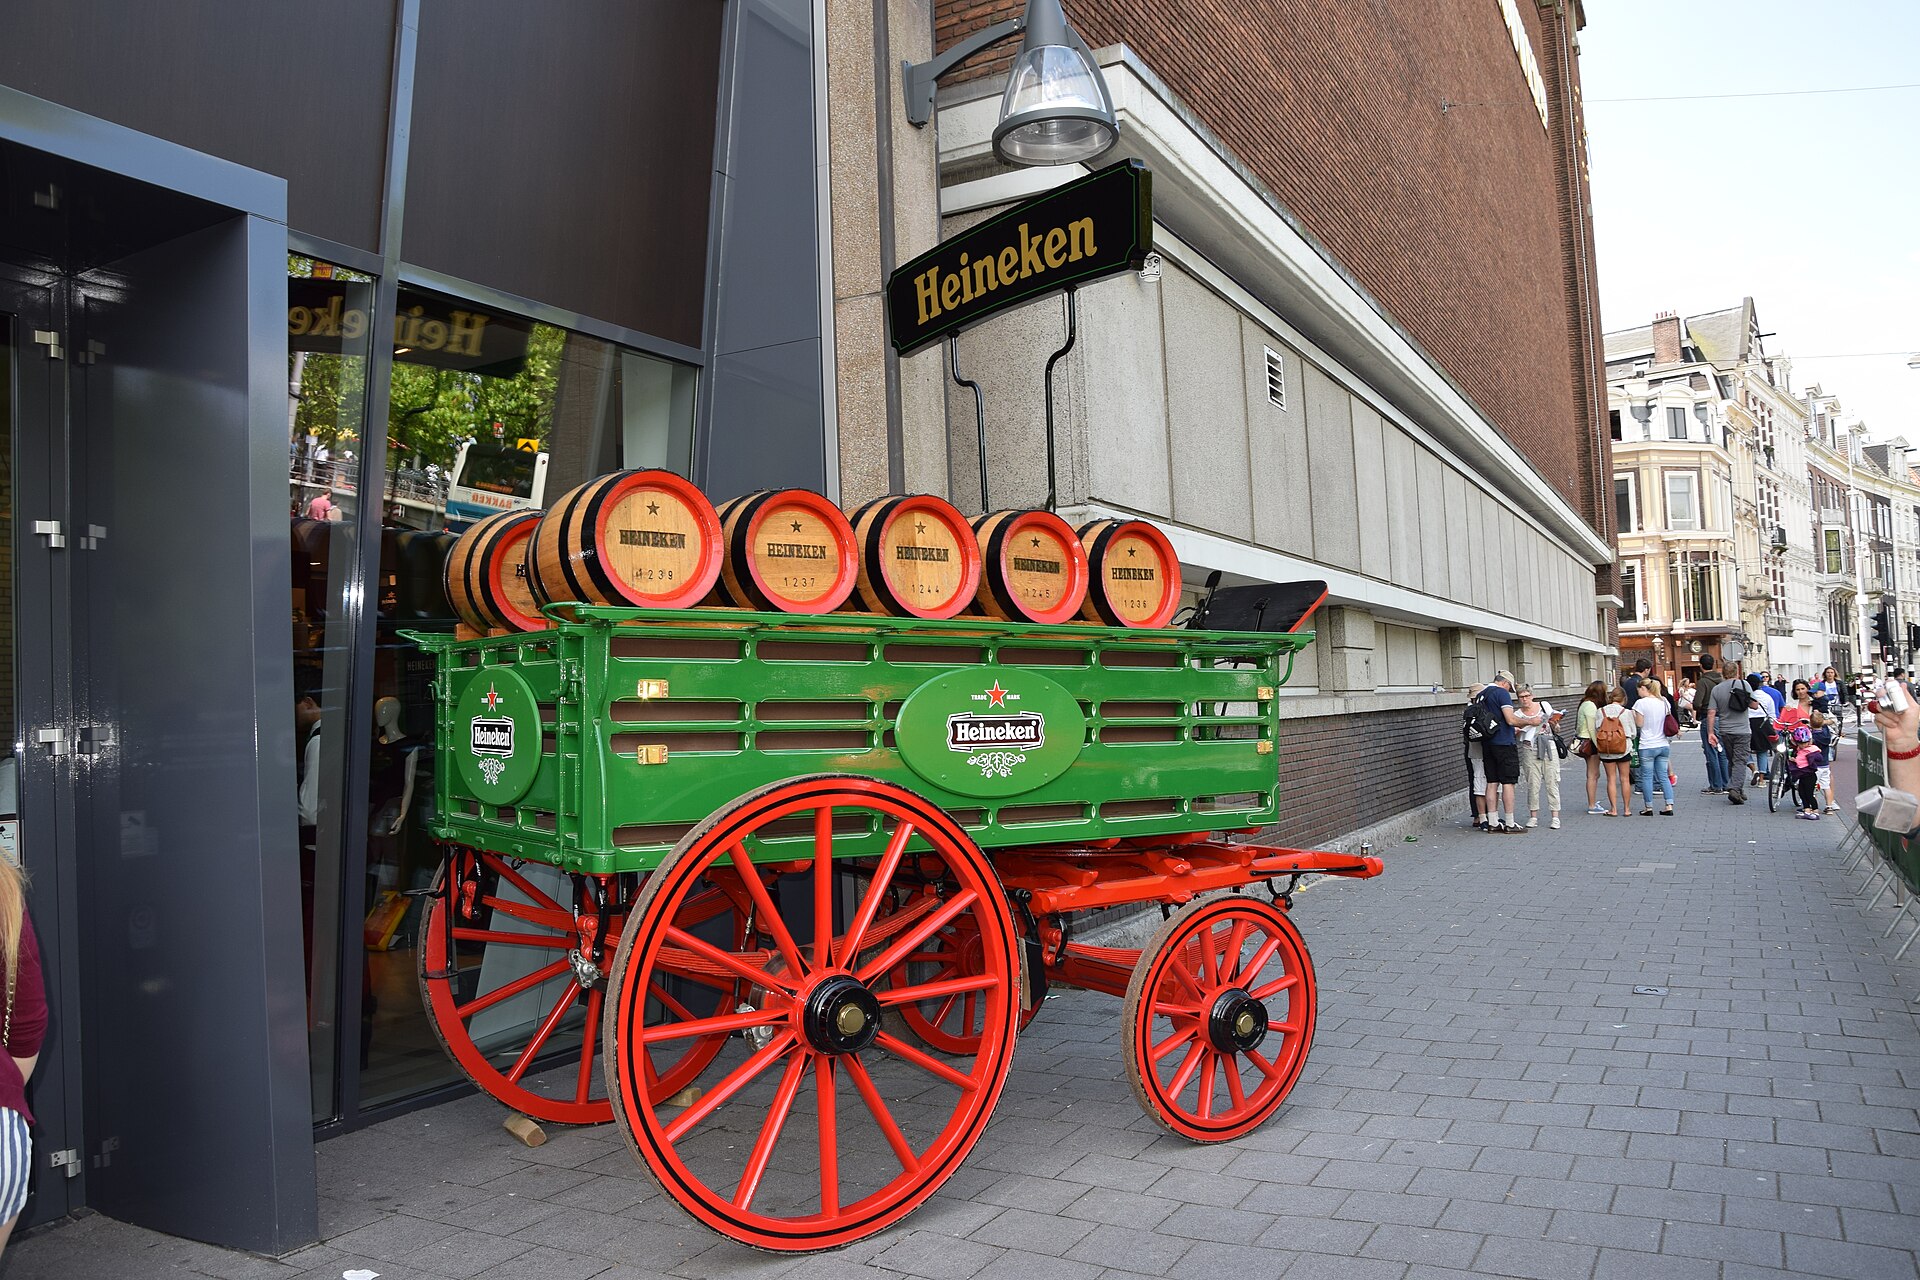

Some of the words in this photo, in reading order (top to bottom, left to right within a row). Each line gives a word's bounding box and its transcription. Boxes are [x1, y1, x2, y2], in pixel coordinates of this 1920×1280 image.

[914, 216, 1097, 326] Heineken
[619, 529, 686, 549] HEINEKEN
[767, 542, 827, 560] HEINEKEN
[896, 545, 949, 562] HEINEKEN
[1013, 557, 1060, 574] HEINEKEN
[1111, 567, 1155, 581] HEINEKEN
[783, 577, 816, 588] 1237
[474, 726, 510, 747] Heineken
[956, 722, 1036, 741] Heineken
